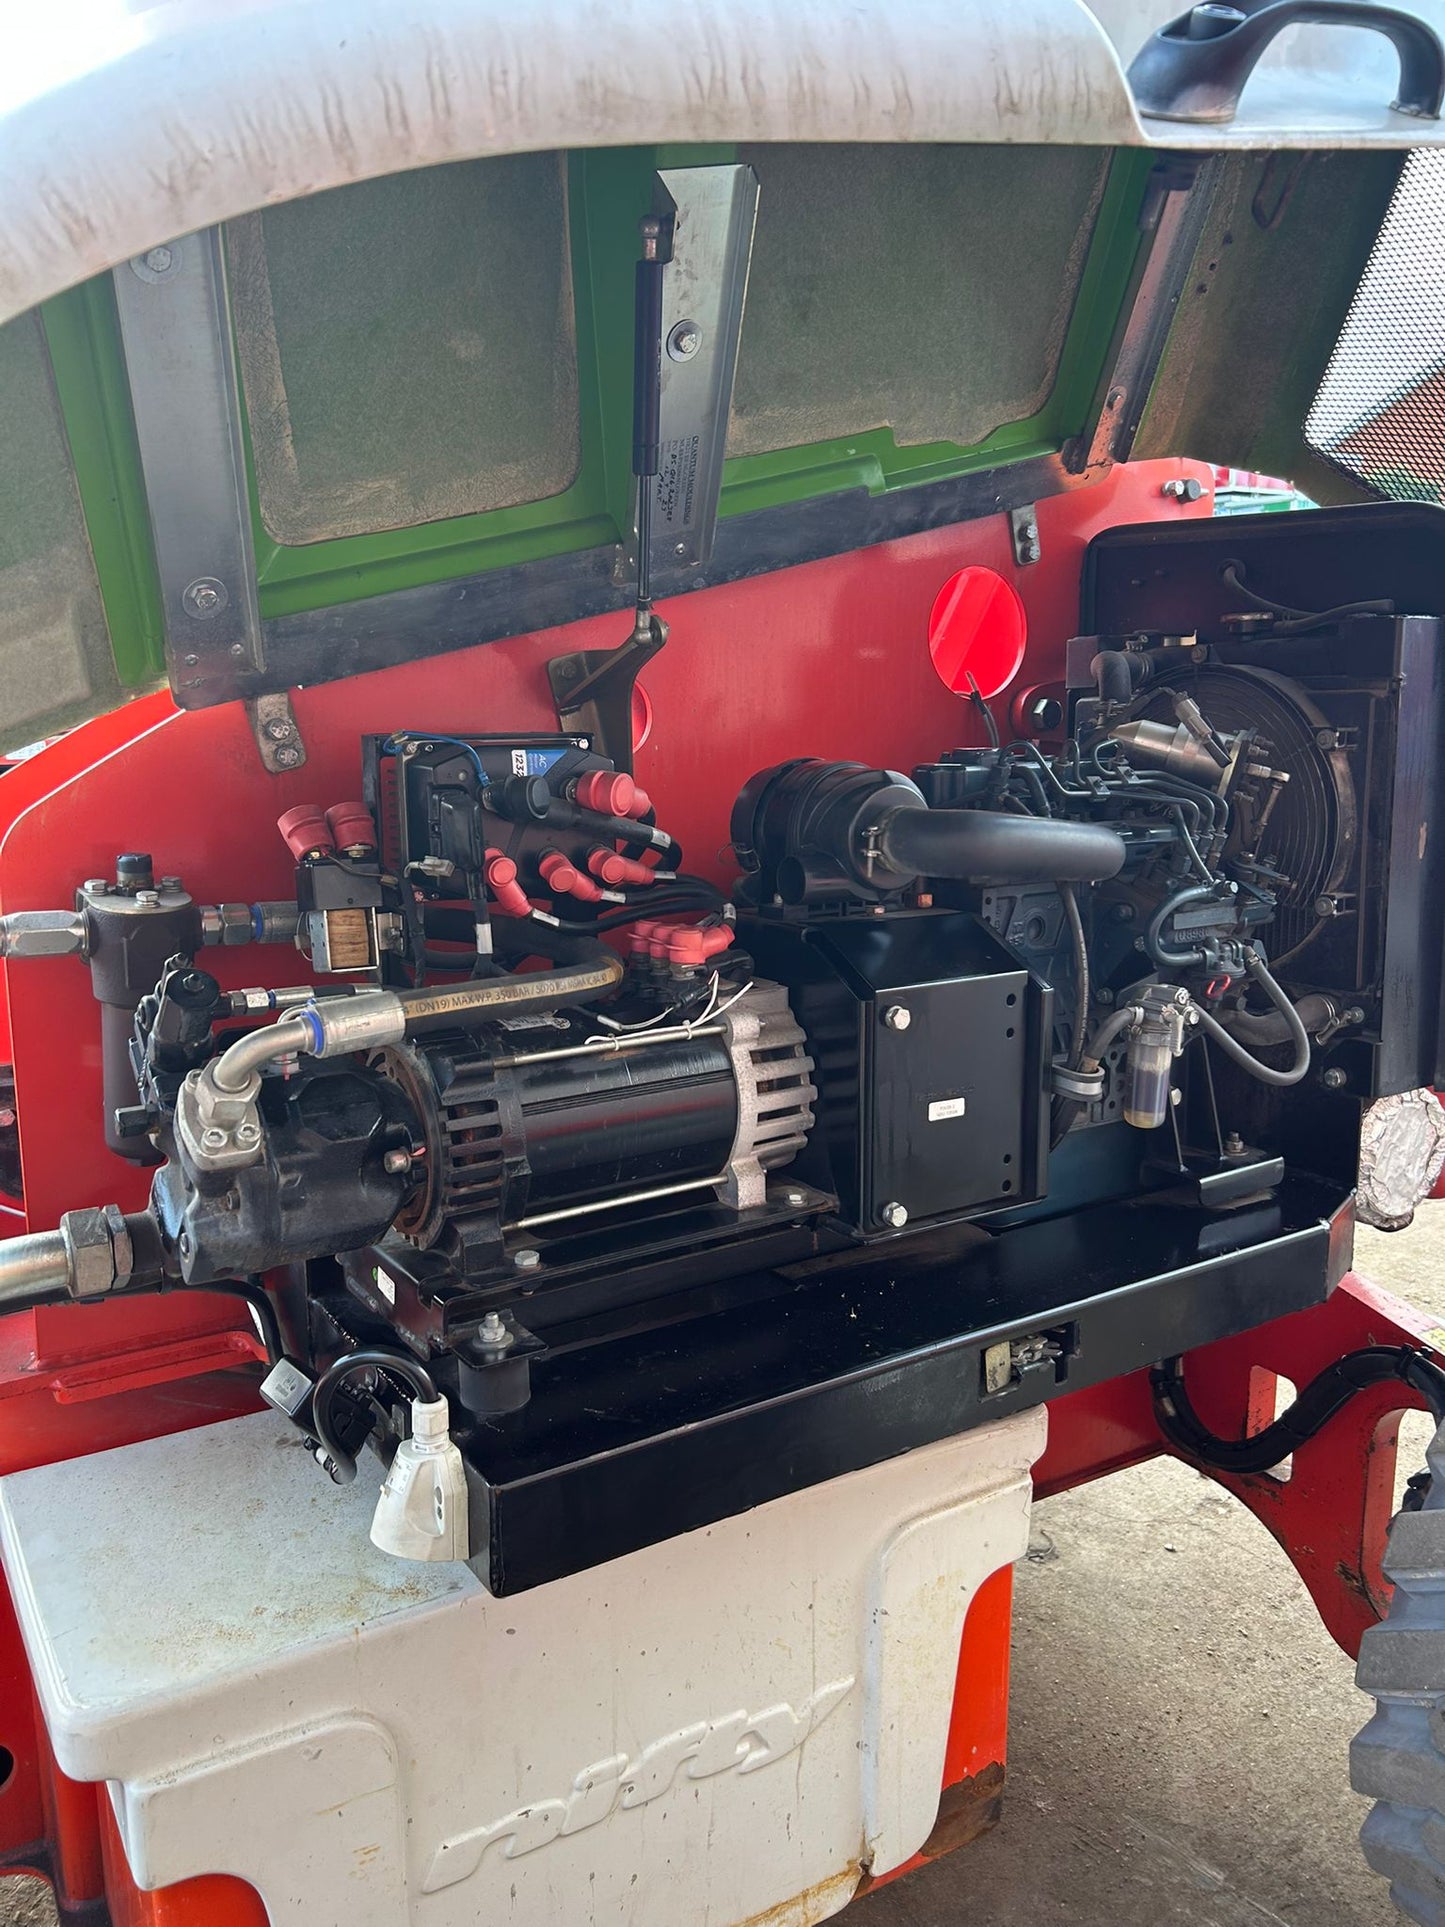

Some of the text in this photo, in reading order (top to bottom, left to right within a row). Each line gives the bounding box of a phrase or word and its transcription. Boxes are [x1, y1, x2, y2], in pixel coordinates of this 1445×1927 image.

[539, 753, 547, 768] AC
[415, 999, 450, 1013] (DN19)
[452, 994, 475, 1006] MAX
[495, 989, 512, 1000] 350
[512, 986, 530, 998] BAR
